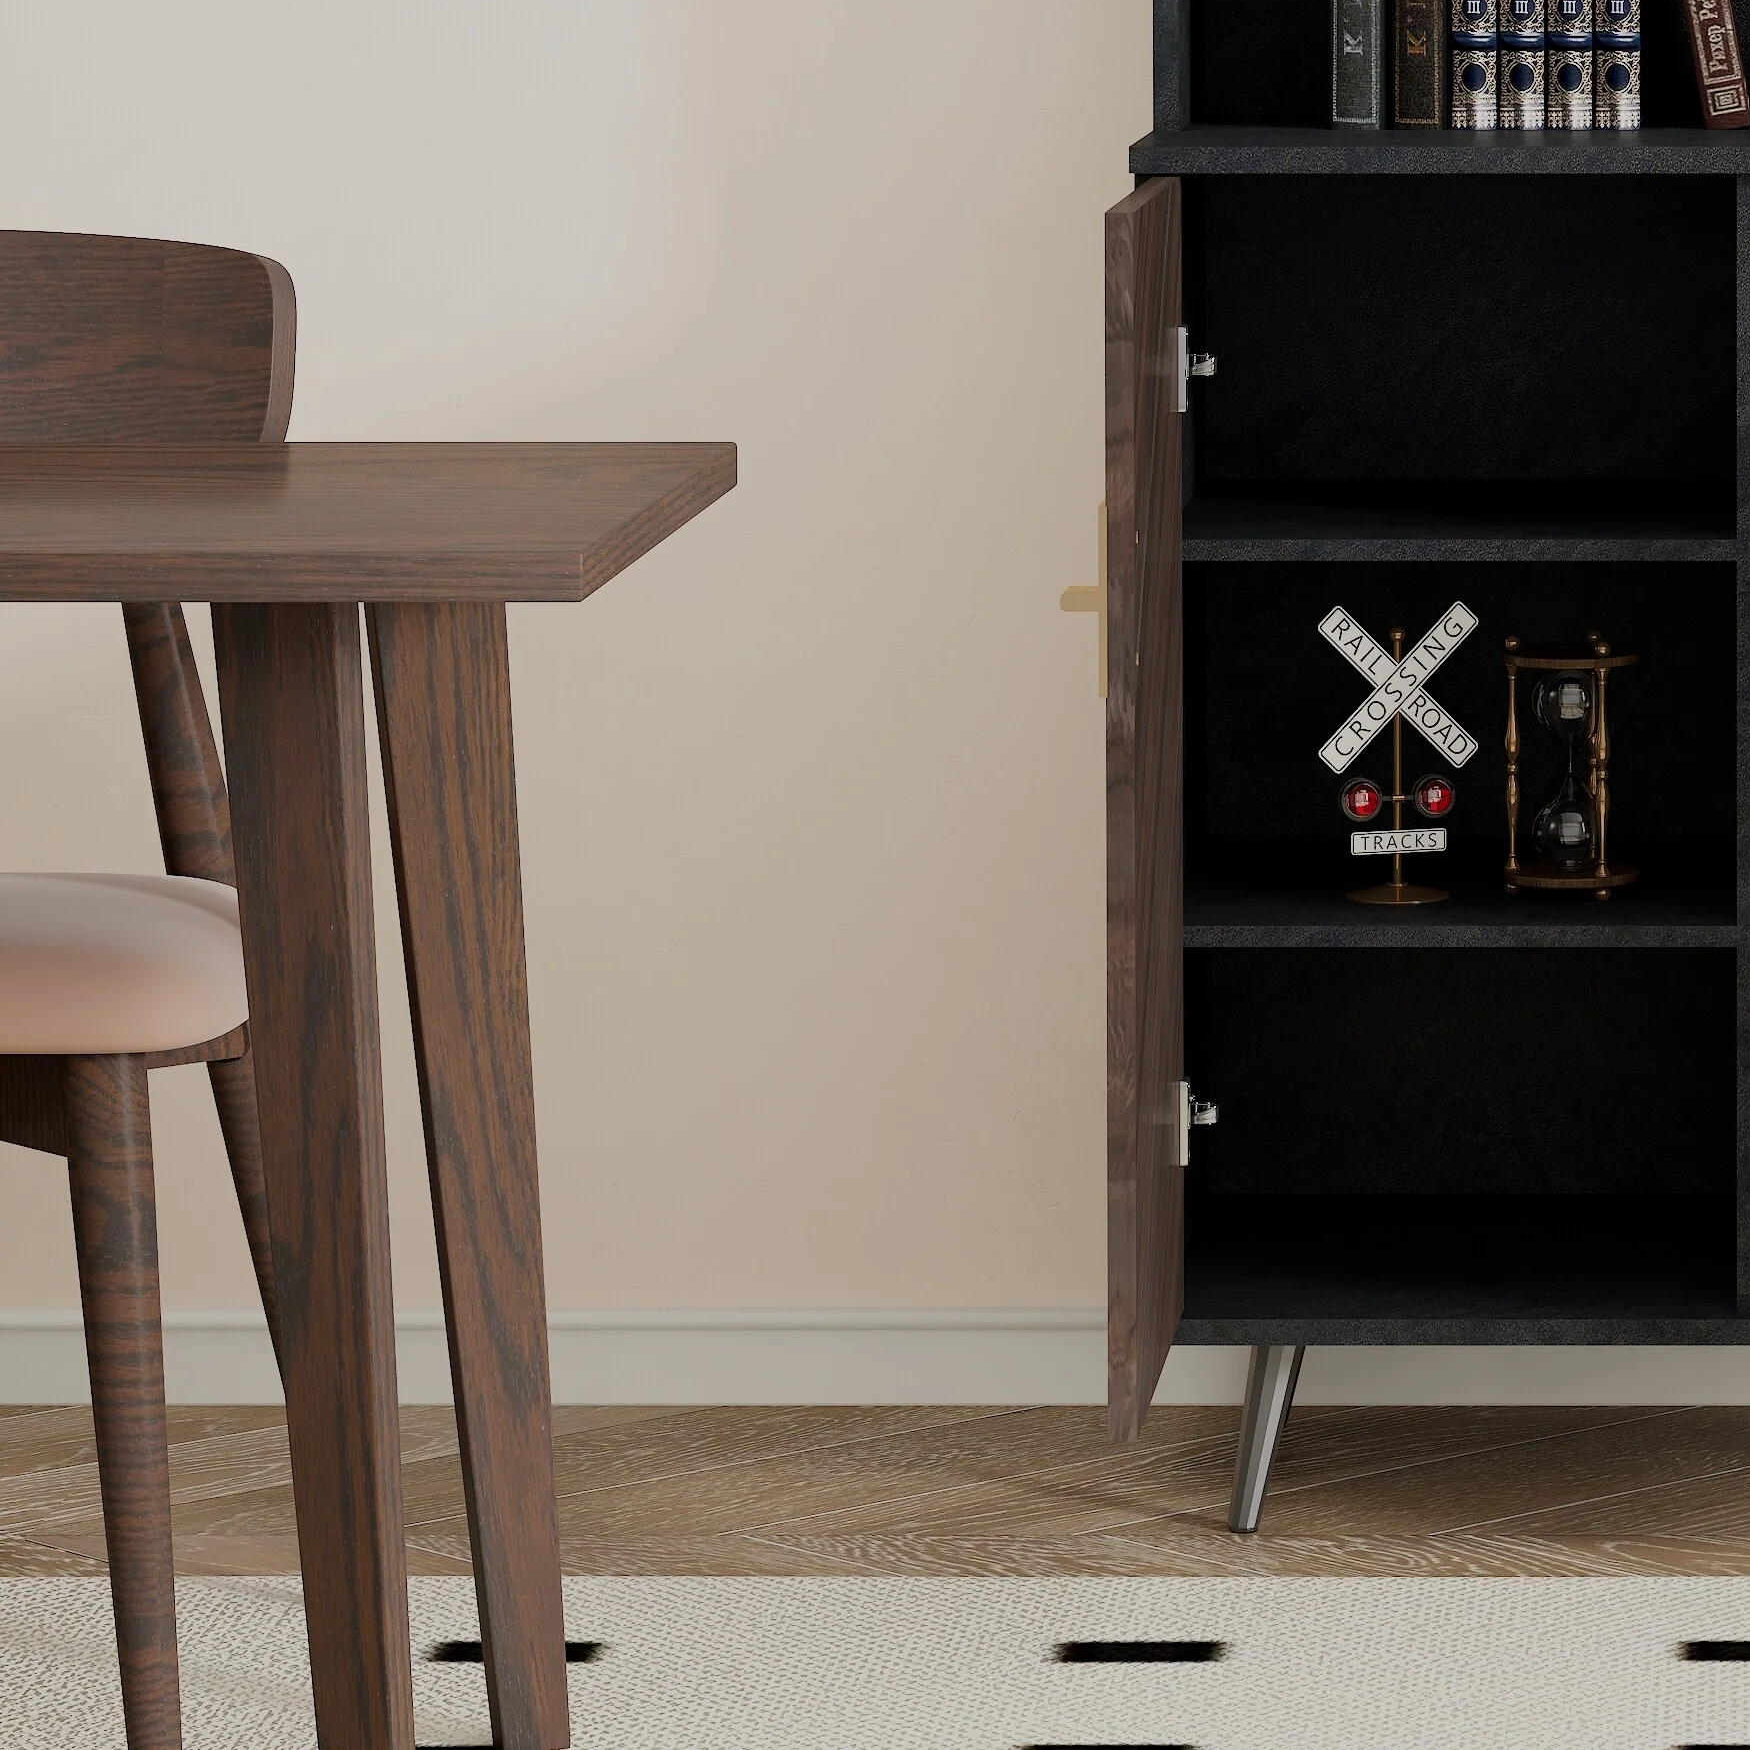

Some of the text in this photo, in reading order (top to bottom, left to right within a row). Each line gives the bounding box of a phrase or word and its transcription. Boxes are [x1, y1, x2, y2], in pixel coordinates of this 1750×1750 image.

[1331, 618, 1383, 676] RAIL
[1335, 616, 1464, 756] CROSSING
[1407, 694, 1468, 755] ROAD
[1360, 832, 1437, 851] TRACKS
